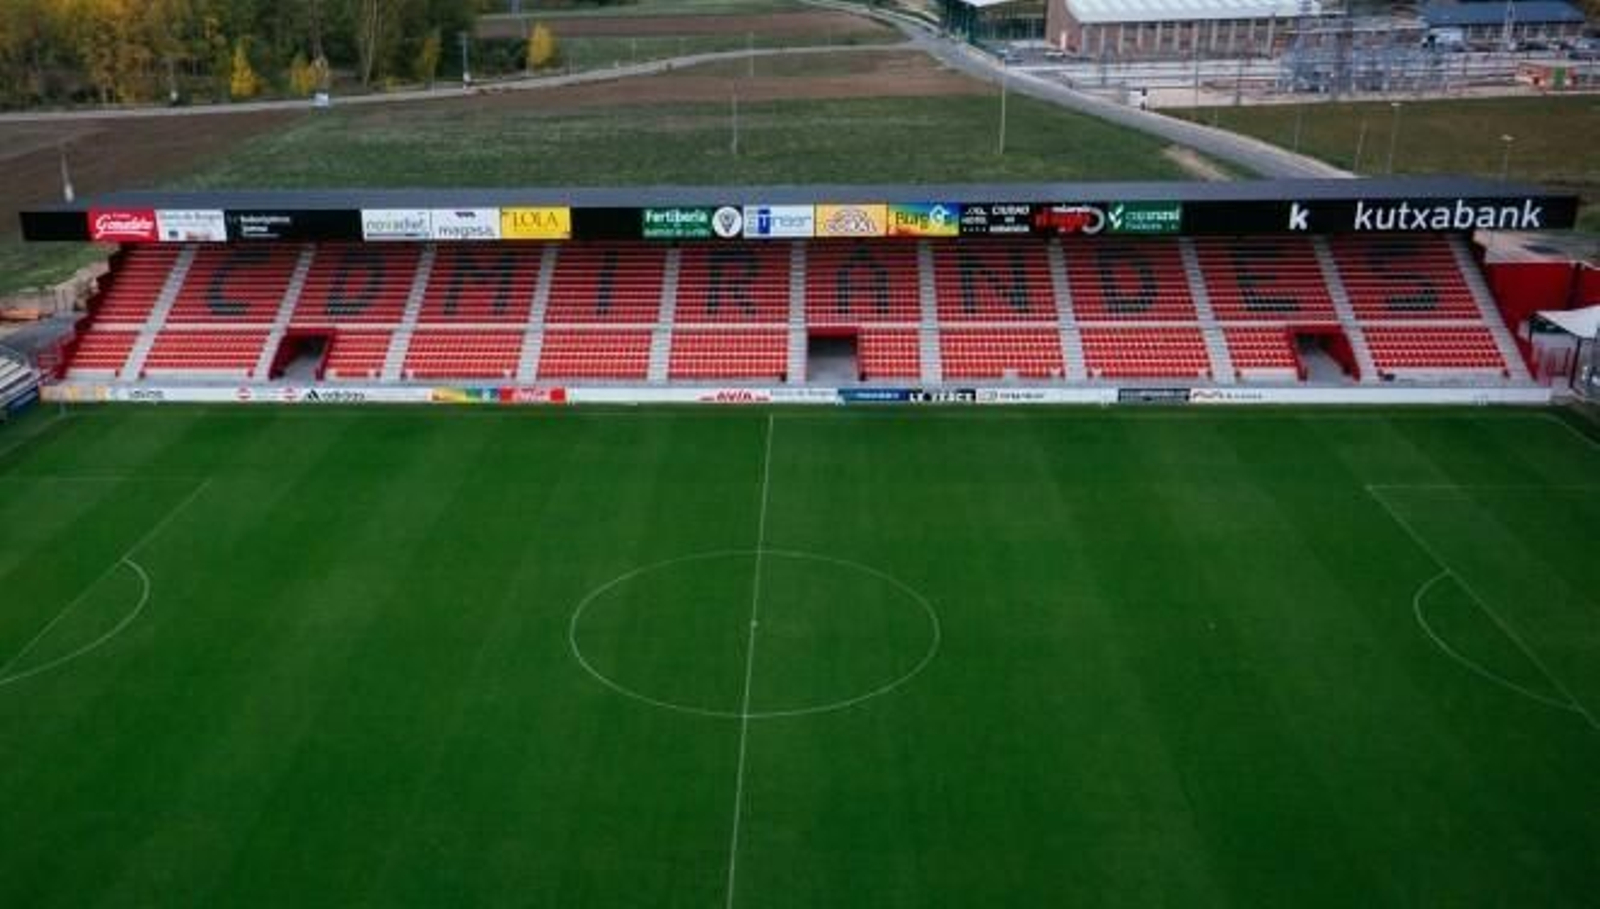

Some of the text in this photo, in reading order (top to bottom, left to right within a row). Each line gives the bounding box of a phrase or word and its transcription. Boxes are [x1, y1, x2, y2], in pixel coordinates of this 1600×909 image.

[512, 211, 558, 228] LOLA
[1288, 202, 1310, 230] k
[1353, 199, 1543, 230] kutxabank
